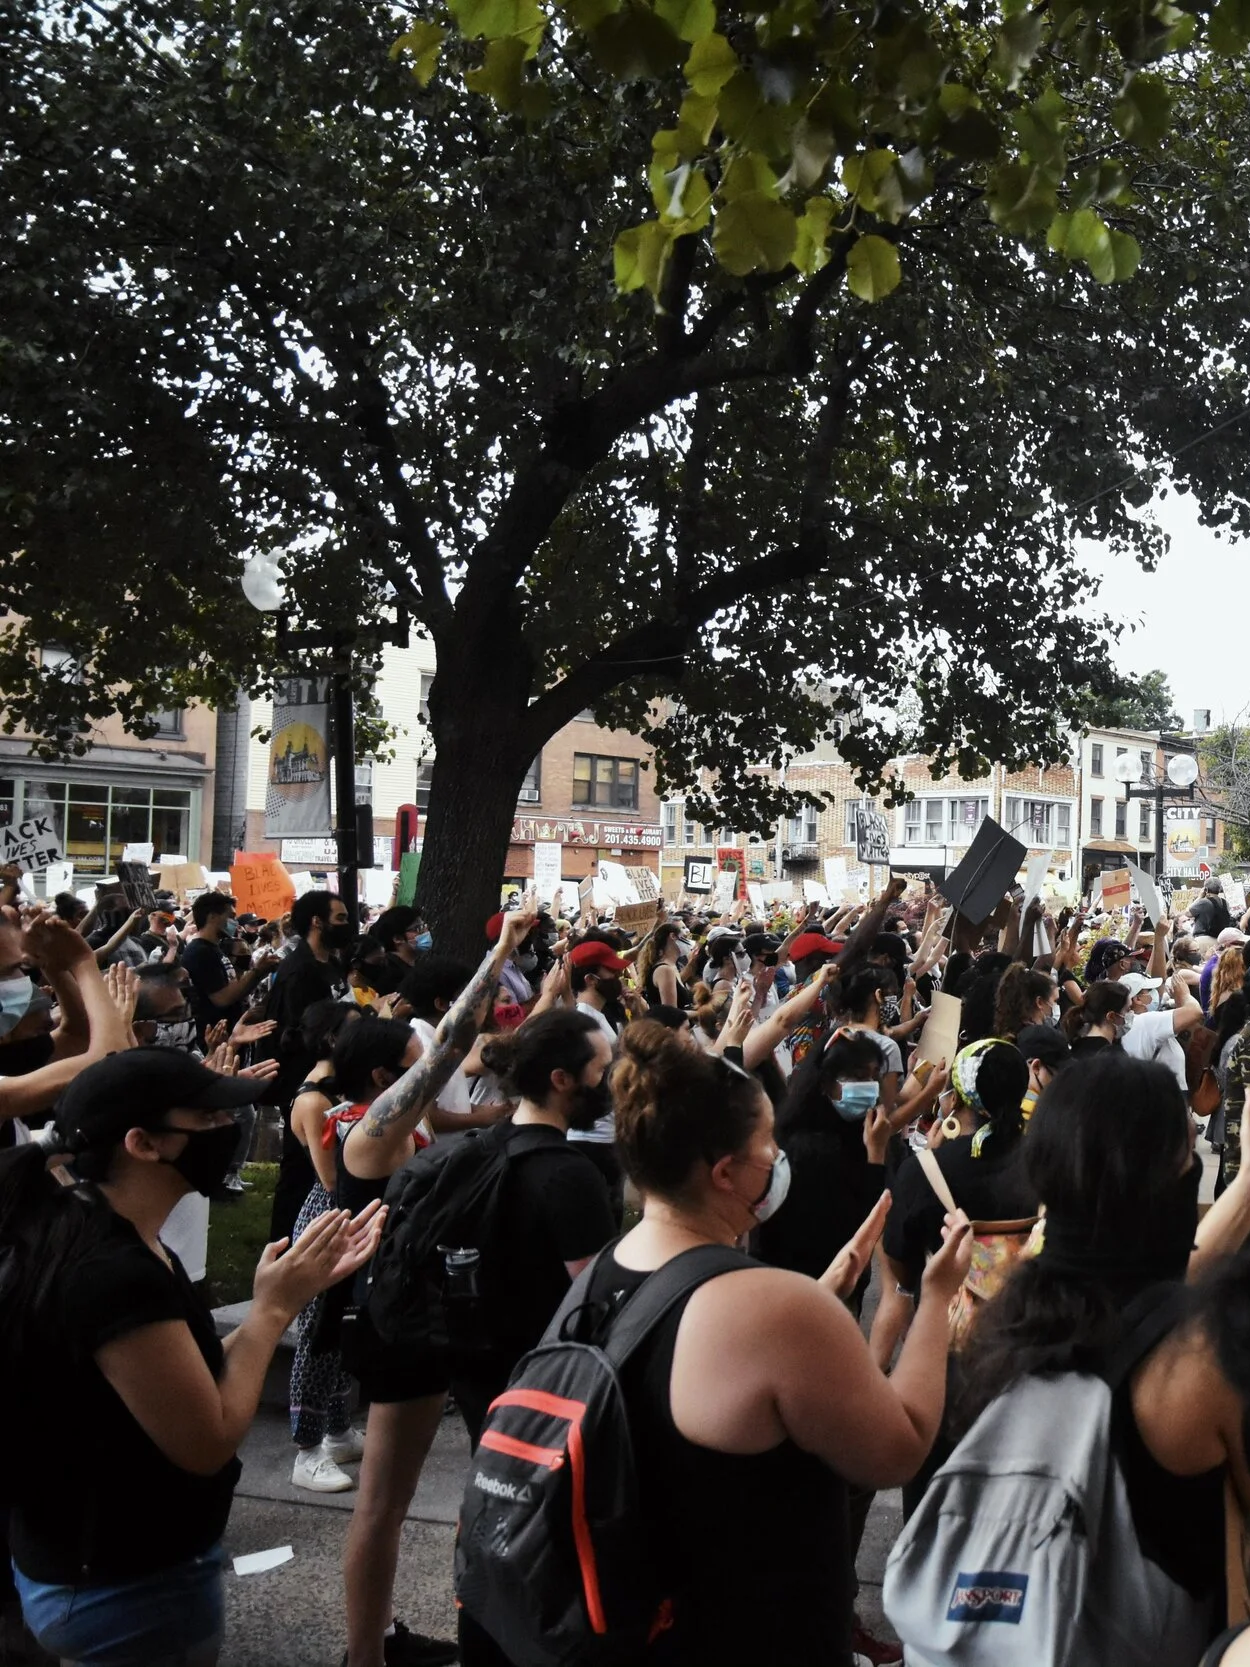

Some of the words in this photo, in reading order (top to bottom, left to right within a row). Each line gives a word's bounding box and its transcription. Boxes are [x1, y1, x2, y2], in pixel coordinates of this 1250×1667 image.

[1167, 807, 1201, 819] CITY
[0, 817, 53, 848] ACK
[557, 821, 600, 845] TAJ
[605, 834, 661, 846] 201.435.4900
[6, 839, 37, 859] IVES
[9, 848, 63, 870] TTER
[245, 865, 277, 881] BLAC
[625, 868, 650, 879] BLACK
[1166, 867, 1182, 877] CITY
[1184, 867, 1200, 877] HALL
[1200, 871, 1210, 881] OP
[634, 879, 655, 890] IVES
[639, 889, 658, 901] ATTE
[474, 1471, 517, 1499] Reebok
